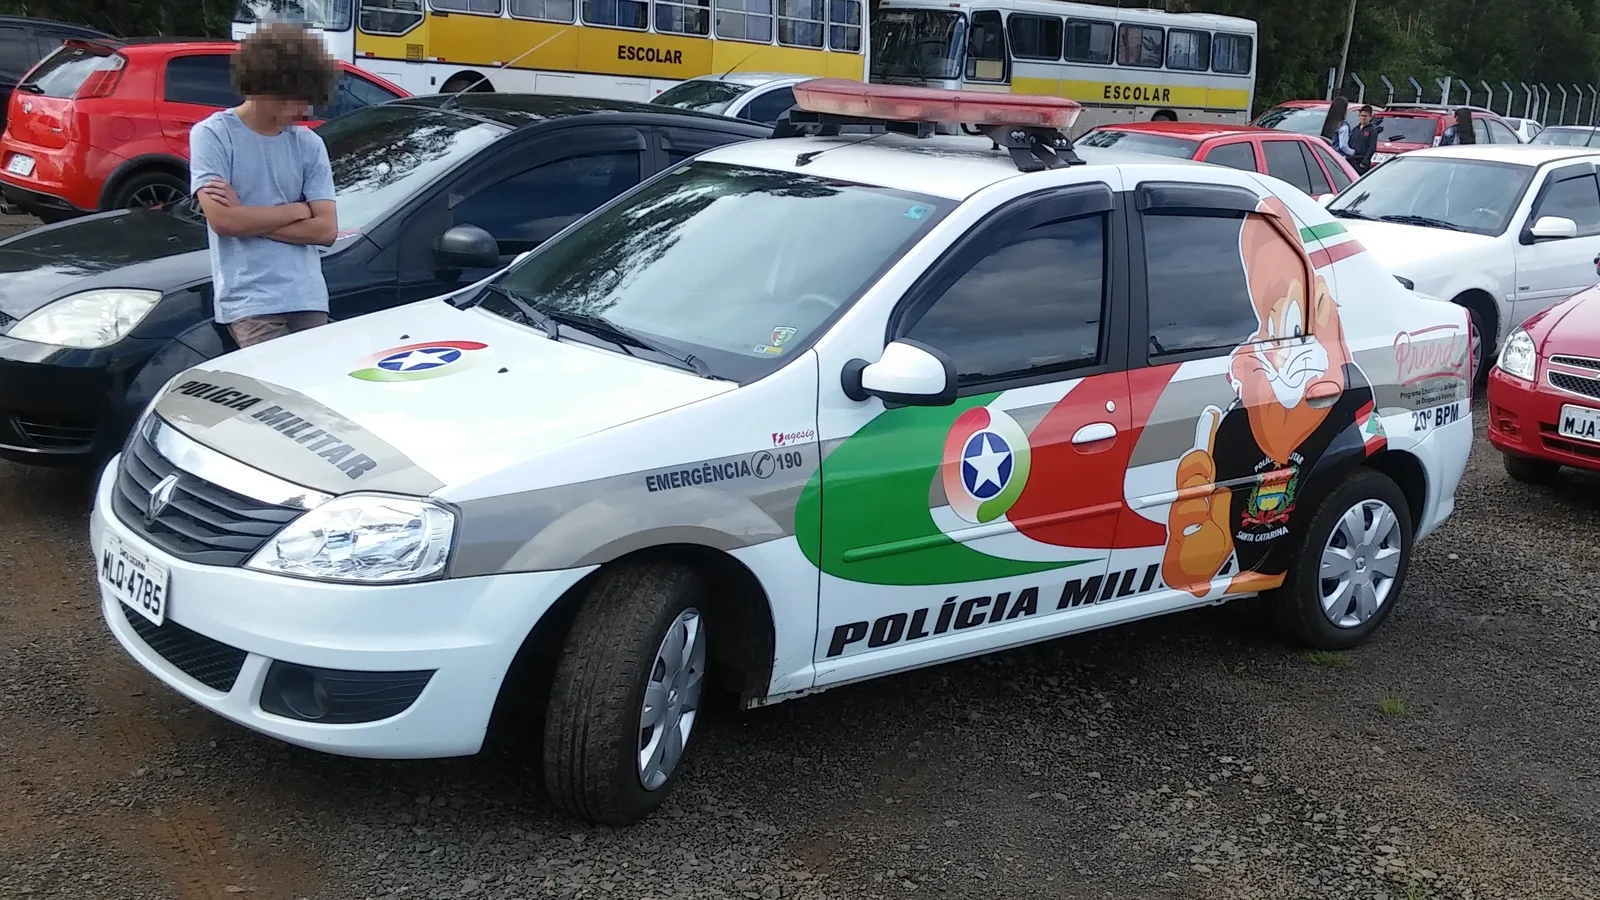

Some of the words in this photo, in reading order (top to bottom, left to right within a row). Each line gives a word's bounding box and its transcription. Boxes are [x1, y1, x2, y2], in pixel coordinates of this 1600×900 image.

[618, 45, 682, 64] ESCOLAR
[1104, 85, 1170, 102] ESCOLAR
[1435, 403, 1459, 427] BPM
[170, 380, 263, 411] POLÍCIA
[251, 405, 378, 480] MILITAR
[645, 460, 751, 492] EMERGÊNCIA
[776, 450, 802, 470] 190
[1236, 530, 1254, 542] SANTA
[1254, 525, 1289, 542] CATARINA
[826, 586, 1039, 658] POLÍCIA
